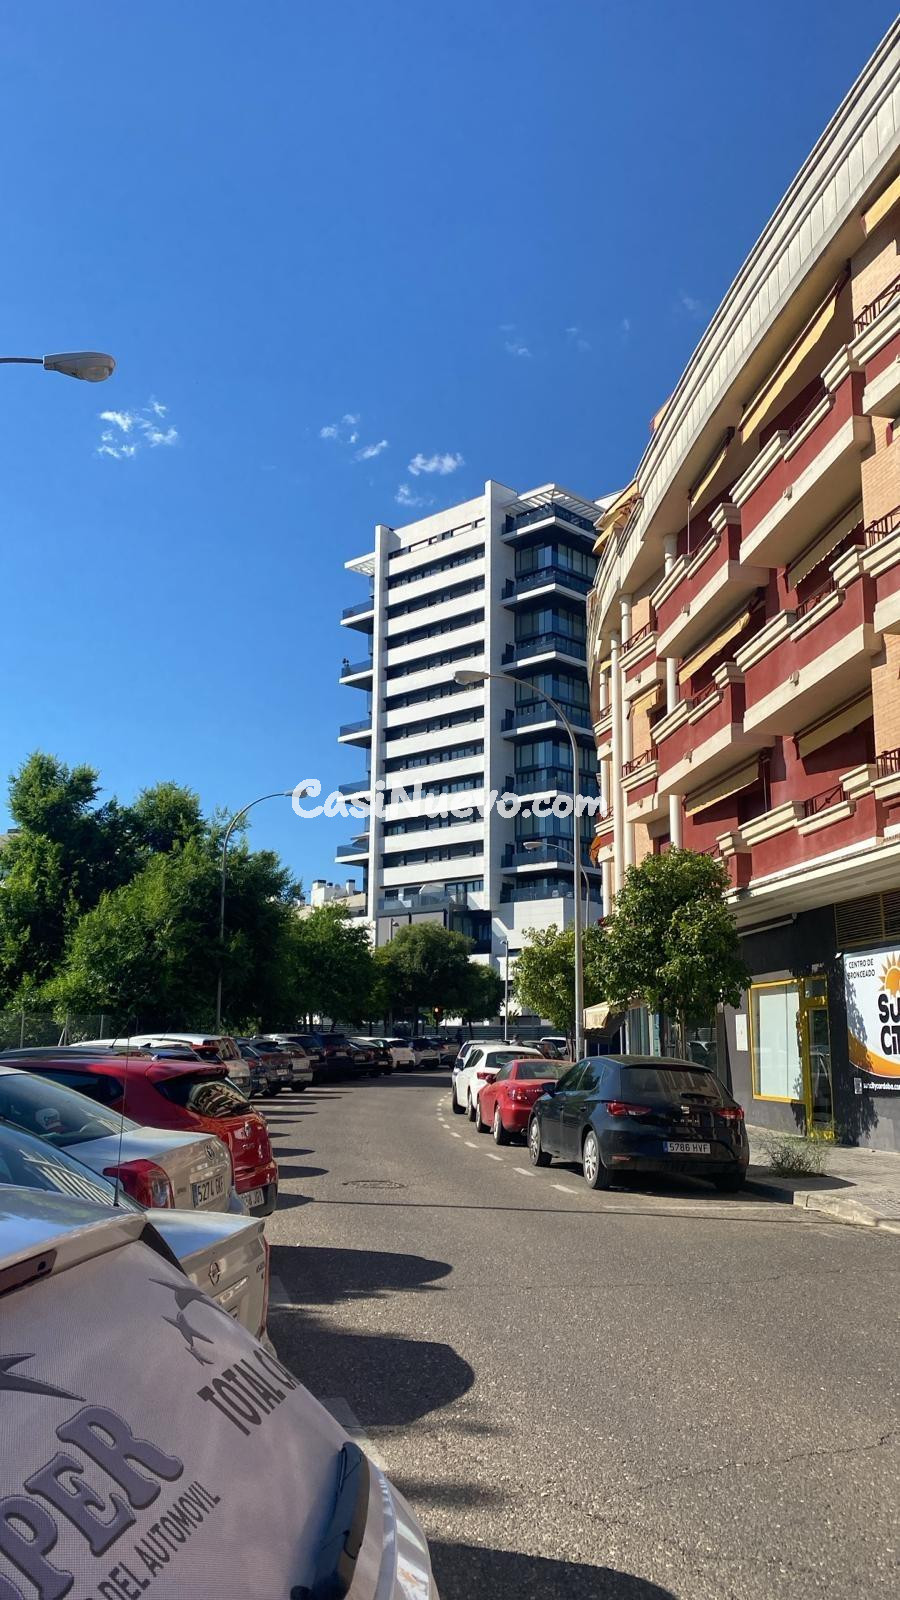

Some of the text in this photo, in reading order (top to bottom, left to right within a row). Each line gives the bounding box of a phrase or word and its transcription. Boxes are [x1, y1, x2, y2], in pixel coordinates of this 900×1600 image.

[847, 969, 876, 979] BRONCEADO
[848, 958, 874, 969] CENTRO DE
[670, 1143, 708, 1152] 5786 HVF
[197, 1358, 286, 1436] TOTAL
[0, 1405, 184, 1600] PER
[134, 1481, 221, 1577] AUTOMOVIL
